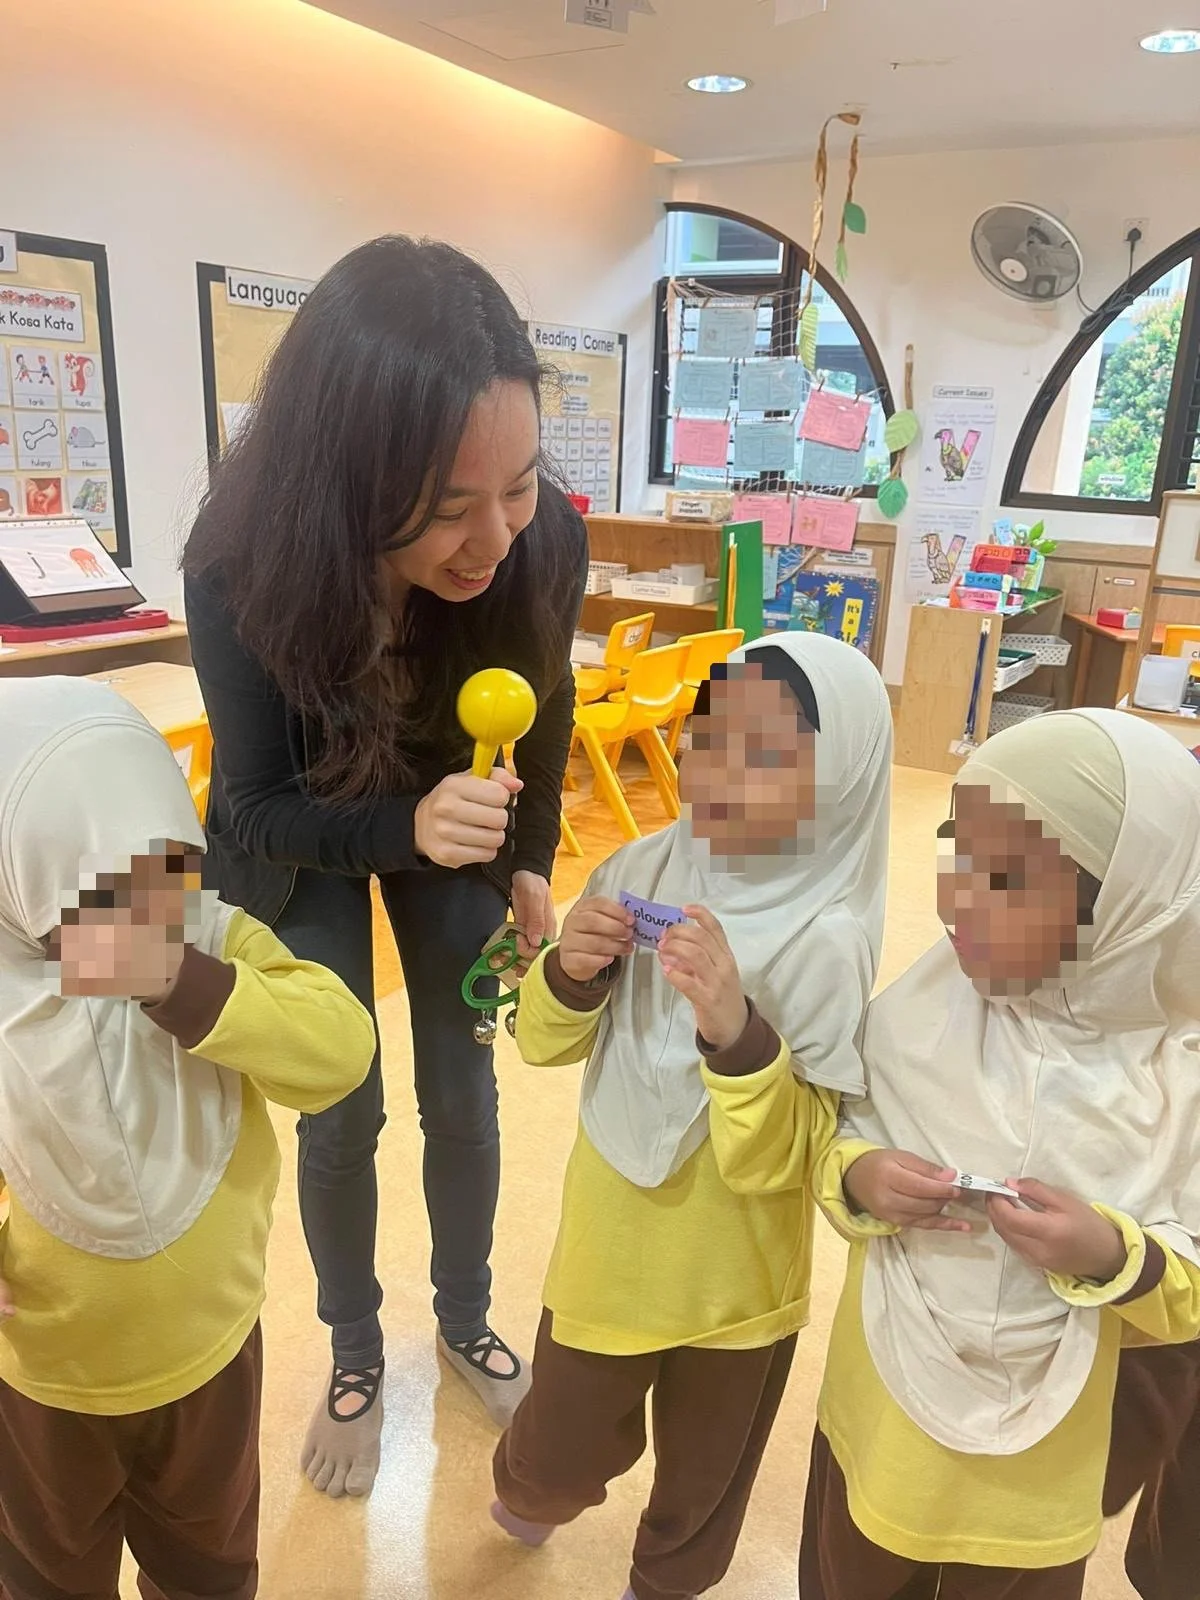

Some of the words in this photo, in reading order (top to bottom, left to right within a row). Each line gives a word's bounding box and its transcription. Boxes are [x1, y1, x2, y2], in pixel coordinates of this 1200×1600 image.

[9, 310, 41, 328] Kosa
[44, 314, 74, 331] Kata
[535, 328, 577, 351] Reading
[583, 334, 615, 352] Corner
[847, 603, 860, 614] It's
